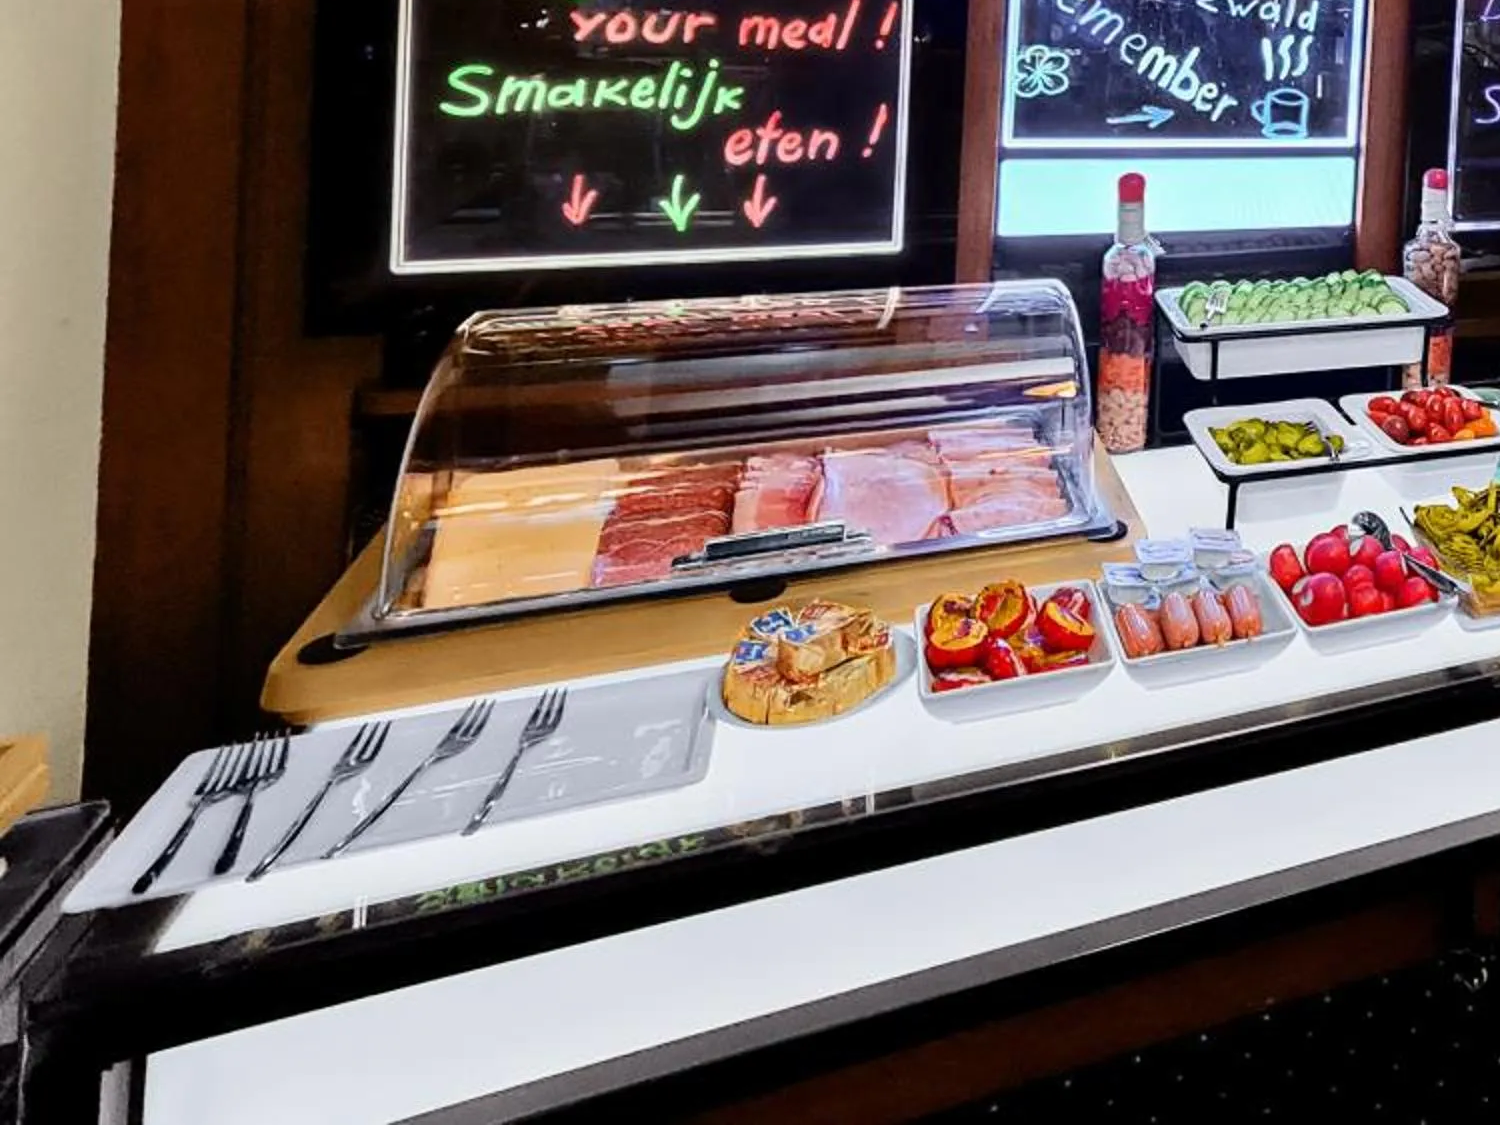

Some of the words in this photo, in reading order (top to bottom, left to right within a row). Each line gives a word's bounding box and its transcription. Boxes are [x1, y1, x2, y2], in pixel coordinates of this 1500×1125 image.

[569, 9, 716, 45] your
[439, 58, 746, 132] Smakelijk
[723, 109, 840, 168] eten
